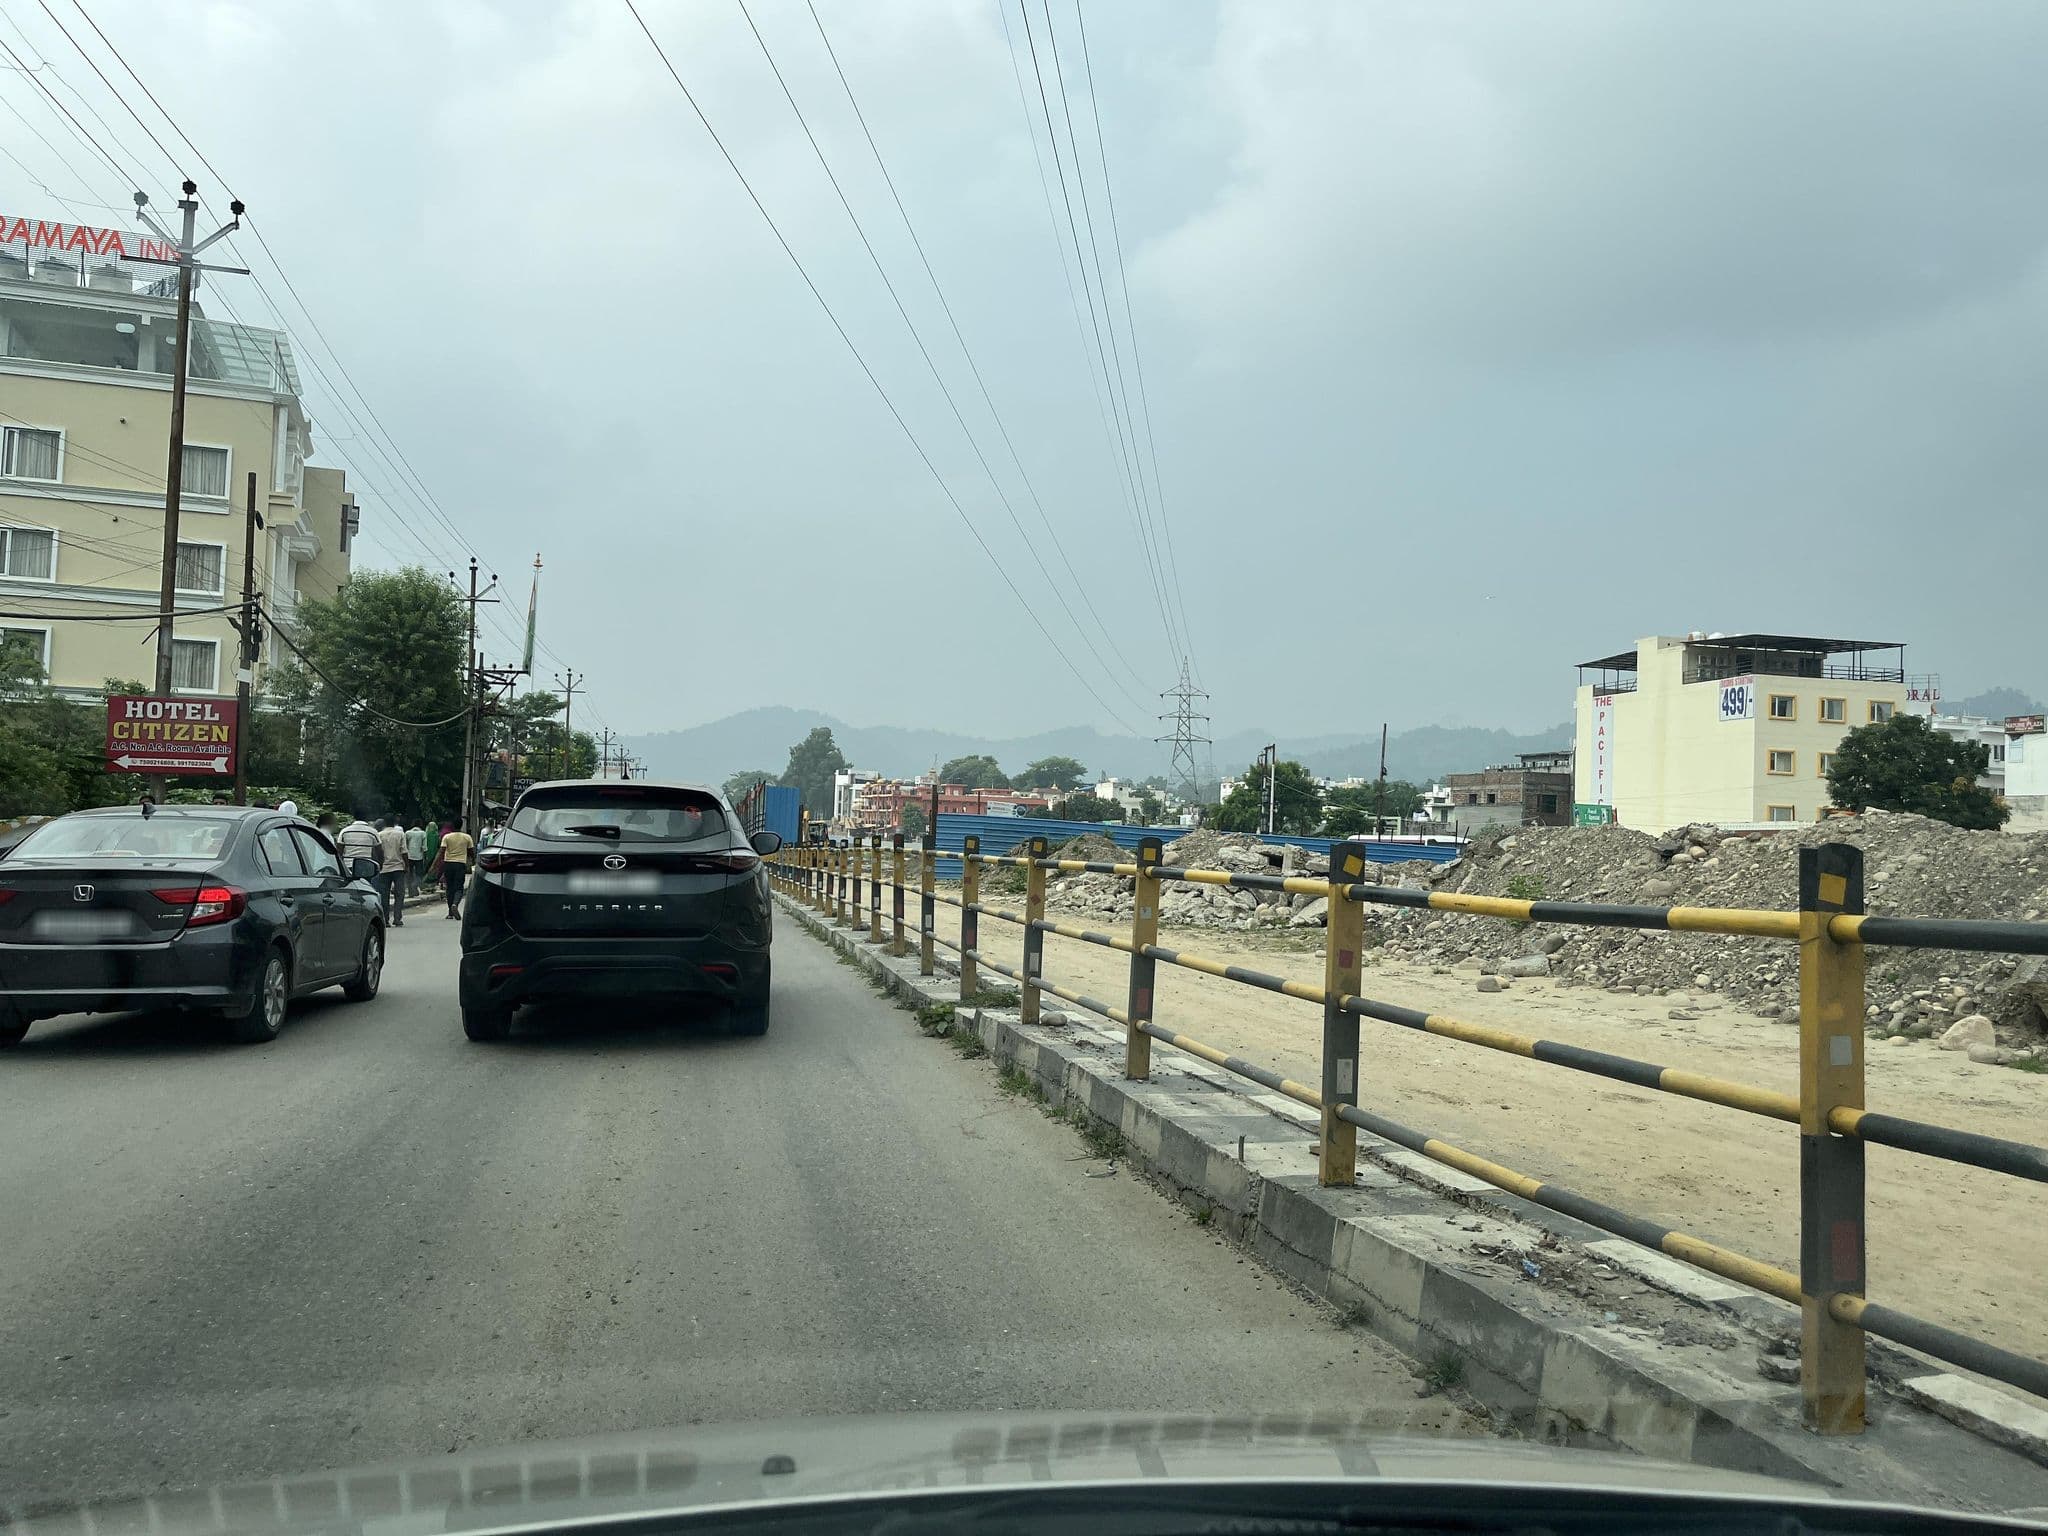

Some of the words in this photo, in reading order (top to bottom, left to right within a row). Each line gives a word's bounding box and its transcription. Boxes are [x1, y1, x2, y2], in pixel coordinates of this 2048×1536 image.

[125, 701, 220, 721] HOTEL
[1595, 696, 1612, 707] THE
[1722, 686, 1753, 717] 499/-
[113, 721, 229, 742] CITIZEN
[129, 742, 147, 752] Non
[166, 743, 193, 753] Rooms
[194, 744, 231, 754] Available
